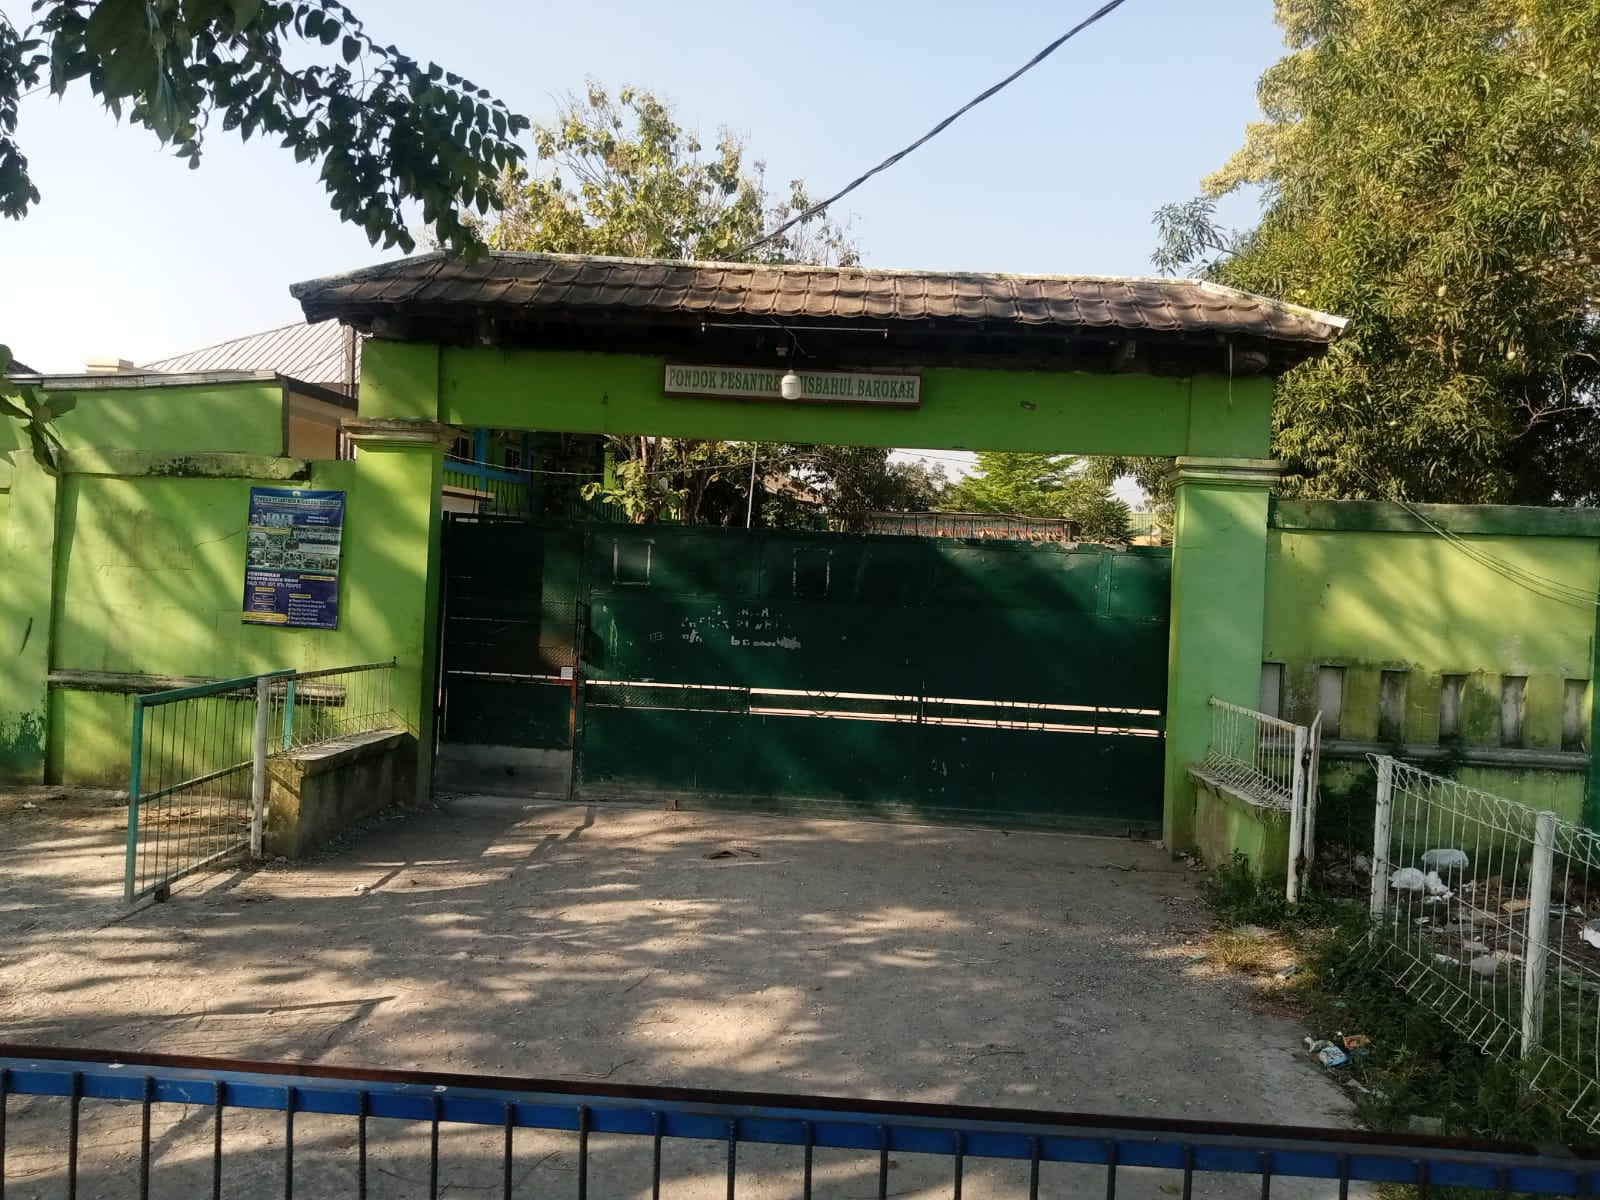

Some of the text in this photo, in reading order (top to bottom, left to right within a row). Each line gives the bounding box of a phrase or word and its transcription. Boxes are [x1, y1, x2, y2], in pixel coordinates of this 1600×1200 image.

[668, 367, 717, 388] PONDOK
[720, 370, 783, 393] PESANTRE
[857, 378, 917, 399] BAROKAH
